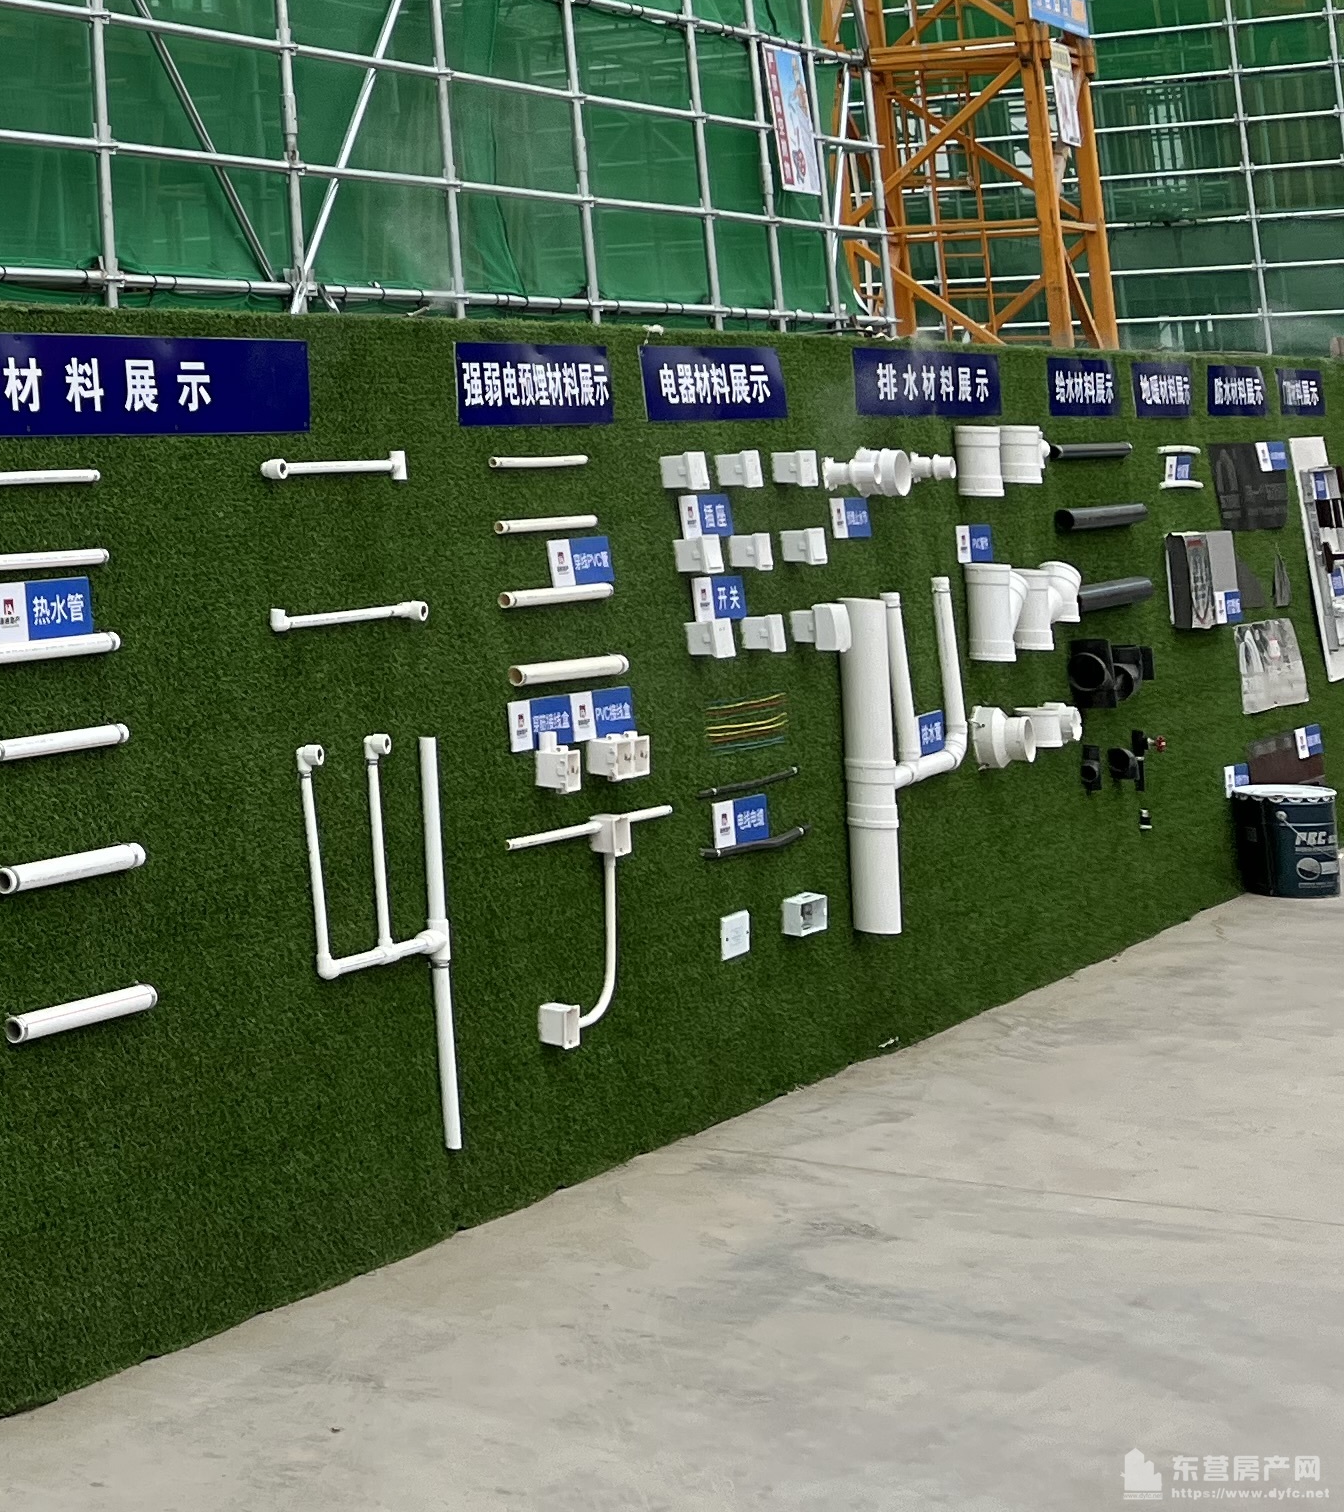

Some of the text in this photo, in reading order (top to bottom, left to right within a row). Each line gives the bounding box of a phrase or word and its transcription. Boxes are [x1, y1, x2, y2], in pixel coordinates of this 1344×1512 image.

[461, 361, 610, 407] 强弱电预埋材料展示
[659, 363, 771, 404] 电器材料展示
[876, 363, 989, 402] 排水材料展示
[32, 592, 85, 626] 热水管
[717, 585, 741, 611] 开关
